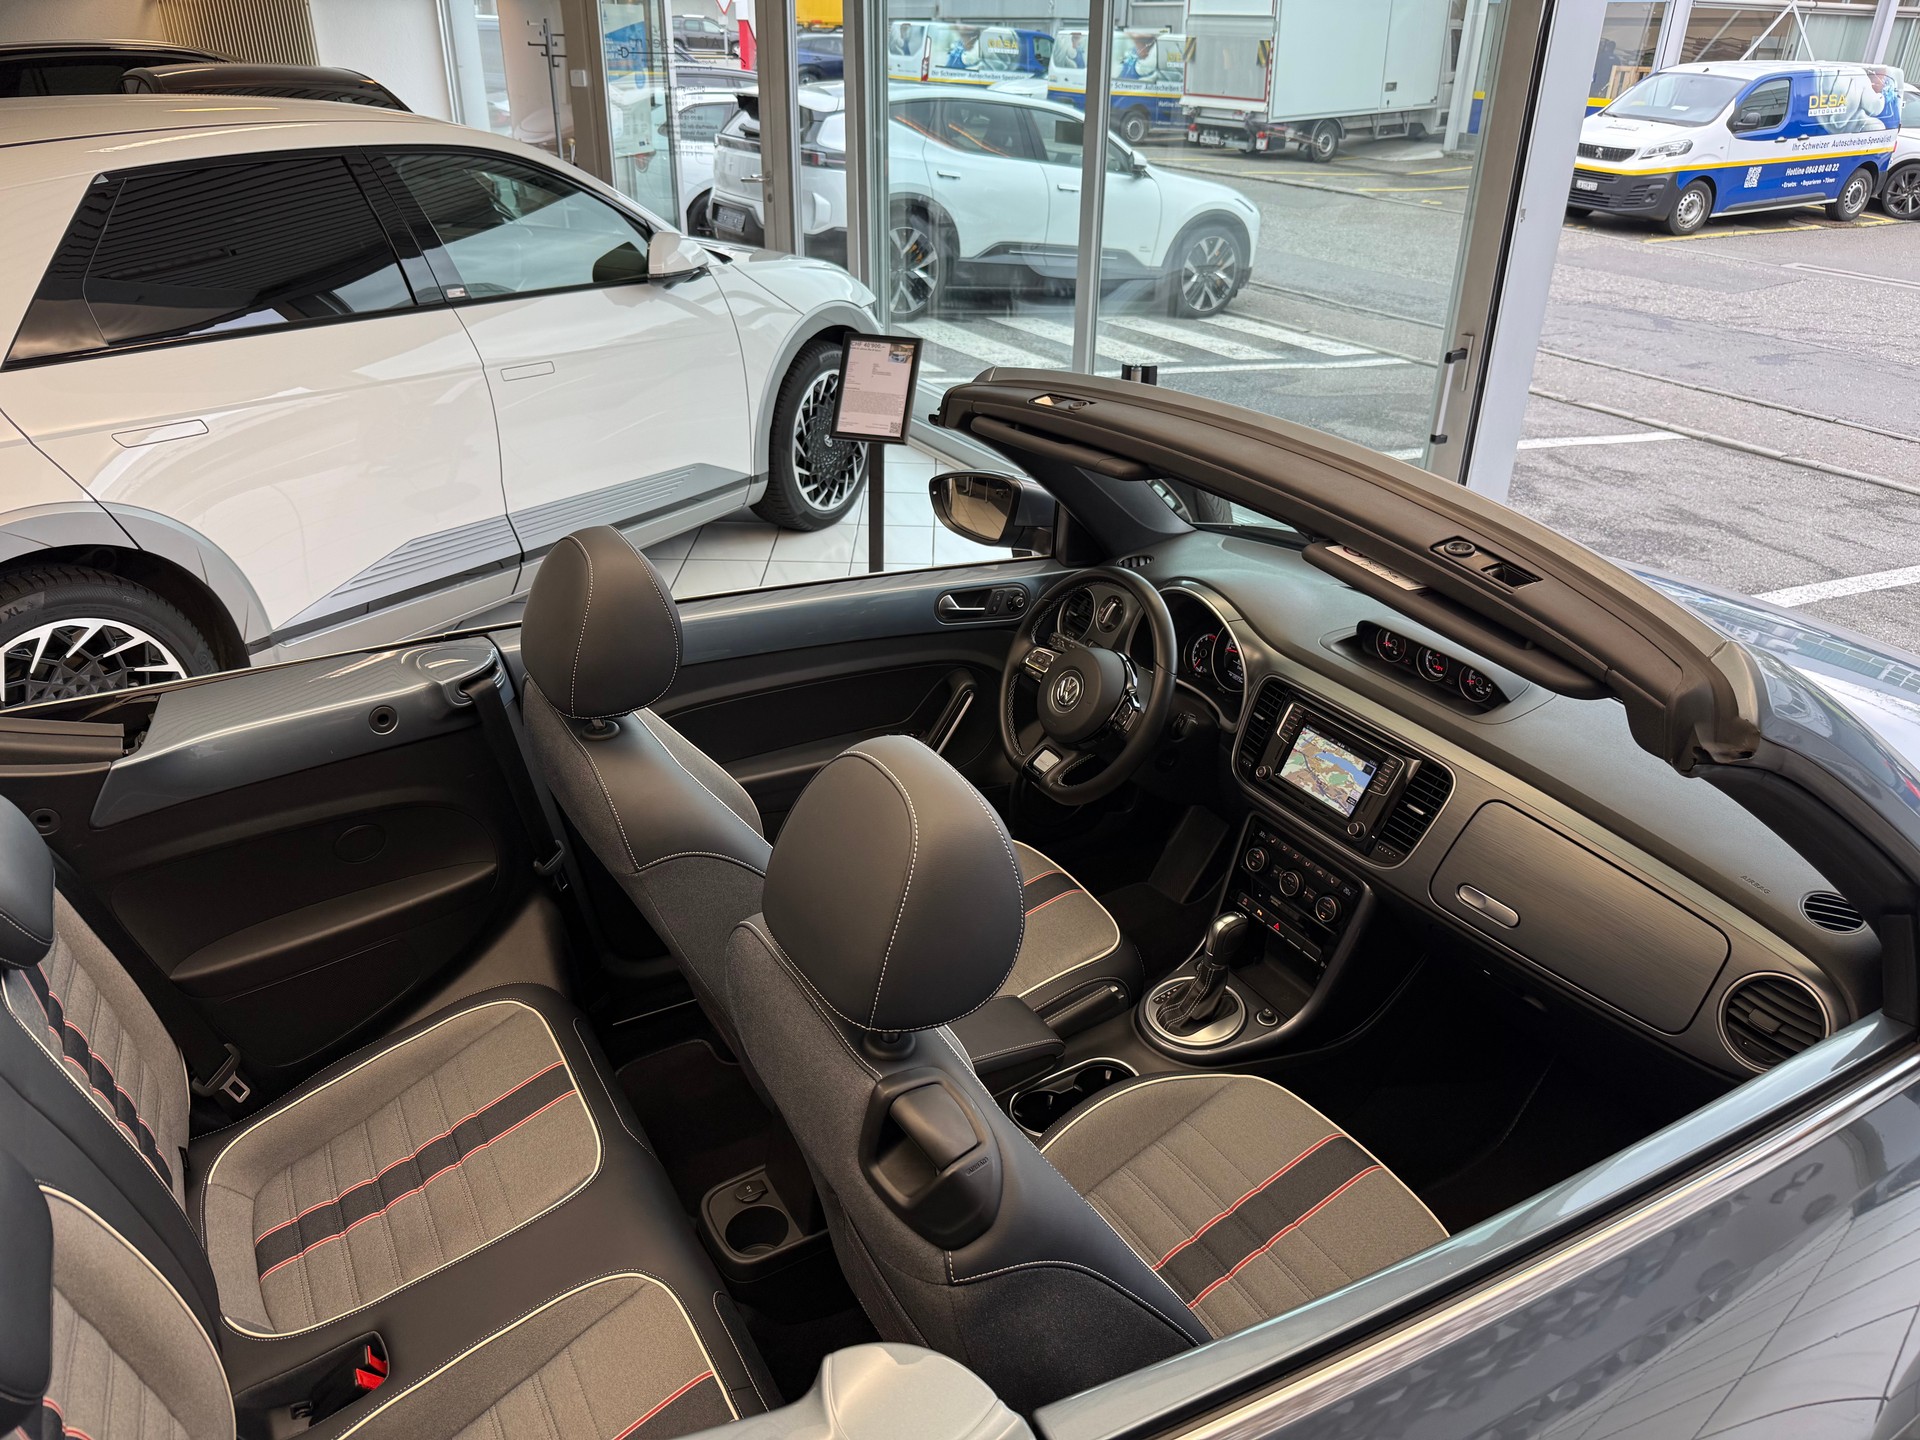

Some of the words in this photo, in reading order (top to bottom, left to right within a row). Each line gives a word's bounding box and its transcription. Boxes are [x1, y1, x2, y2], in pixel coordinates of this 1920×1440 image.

[1809, 94, 1846, 109] DESA
[1809, 108, 1846, 116] AUTOGLASS
[1792, 143, 1801, 151] Ihr
[1801, 141, 1830, 151] Schweizer
[1832, 138, 1867, 148] Autoscheiben
[1867, 135, 1892, 145] Spezialist
[1785, 166, 1805, 176] Hotline
[1832, 163, 1840, 171] 22
[4, 606, 24, 620] XL
[1740, 875, 1771, 894] AIRBAG
